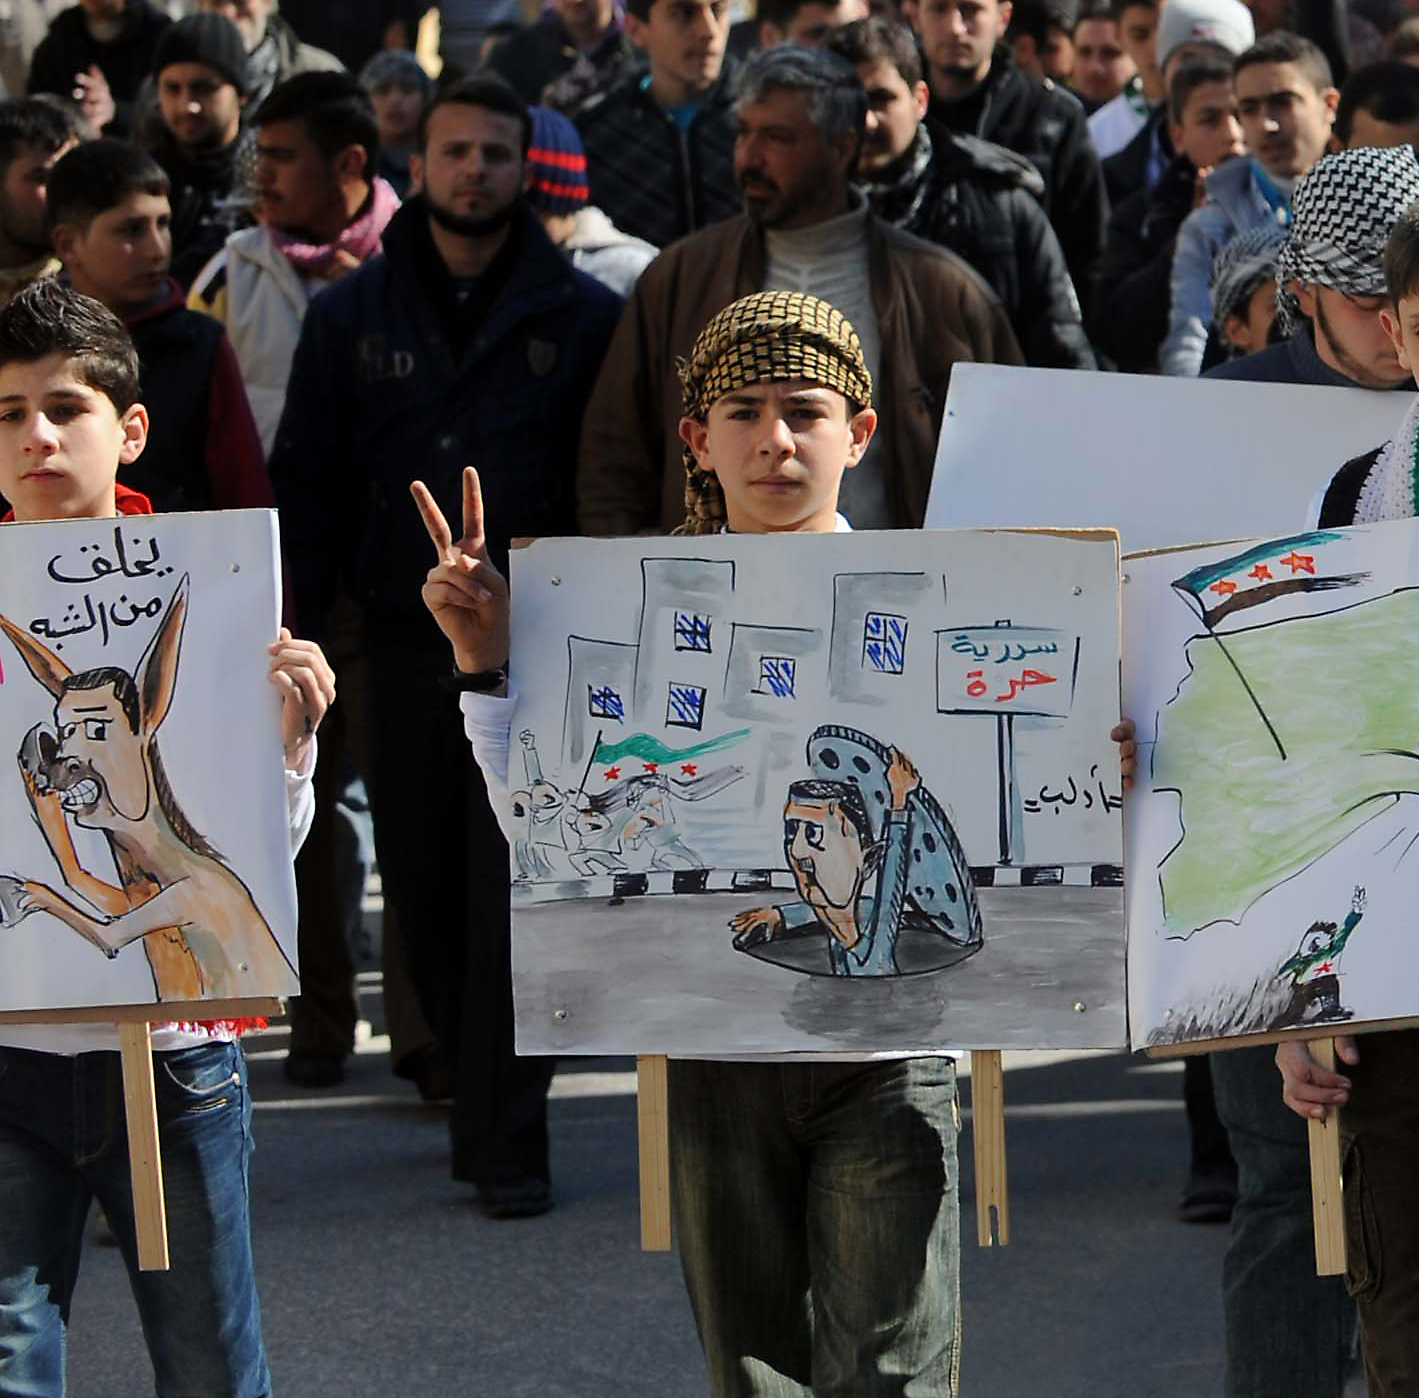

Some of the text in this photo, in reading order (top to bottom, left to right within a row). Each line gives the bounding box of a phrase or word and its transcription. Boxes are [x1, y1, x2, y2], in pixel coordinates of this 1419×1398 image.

[46, 526, 174, 584] يخلق
[28, 593, 163, 651] من الشبه
[965, 668, 1057, 703] حرة
